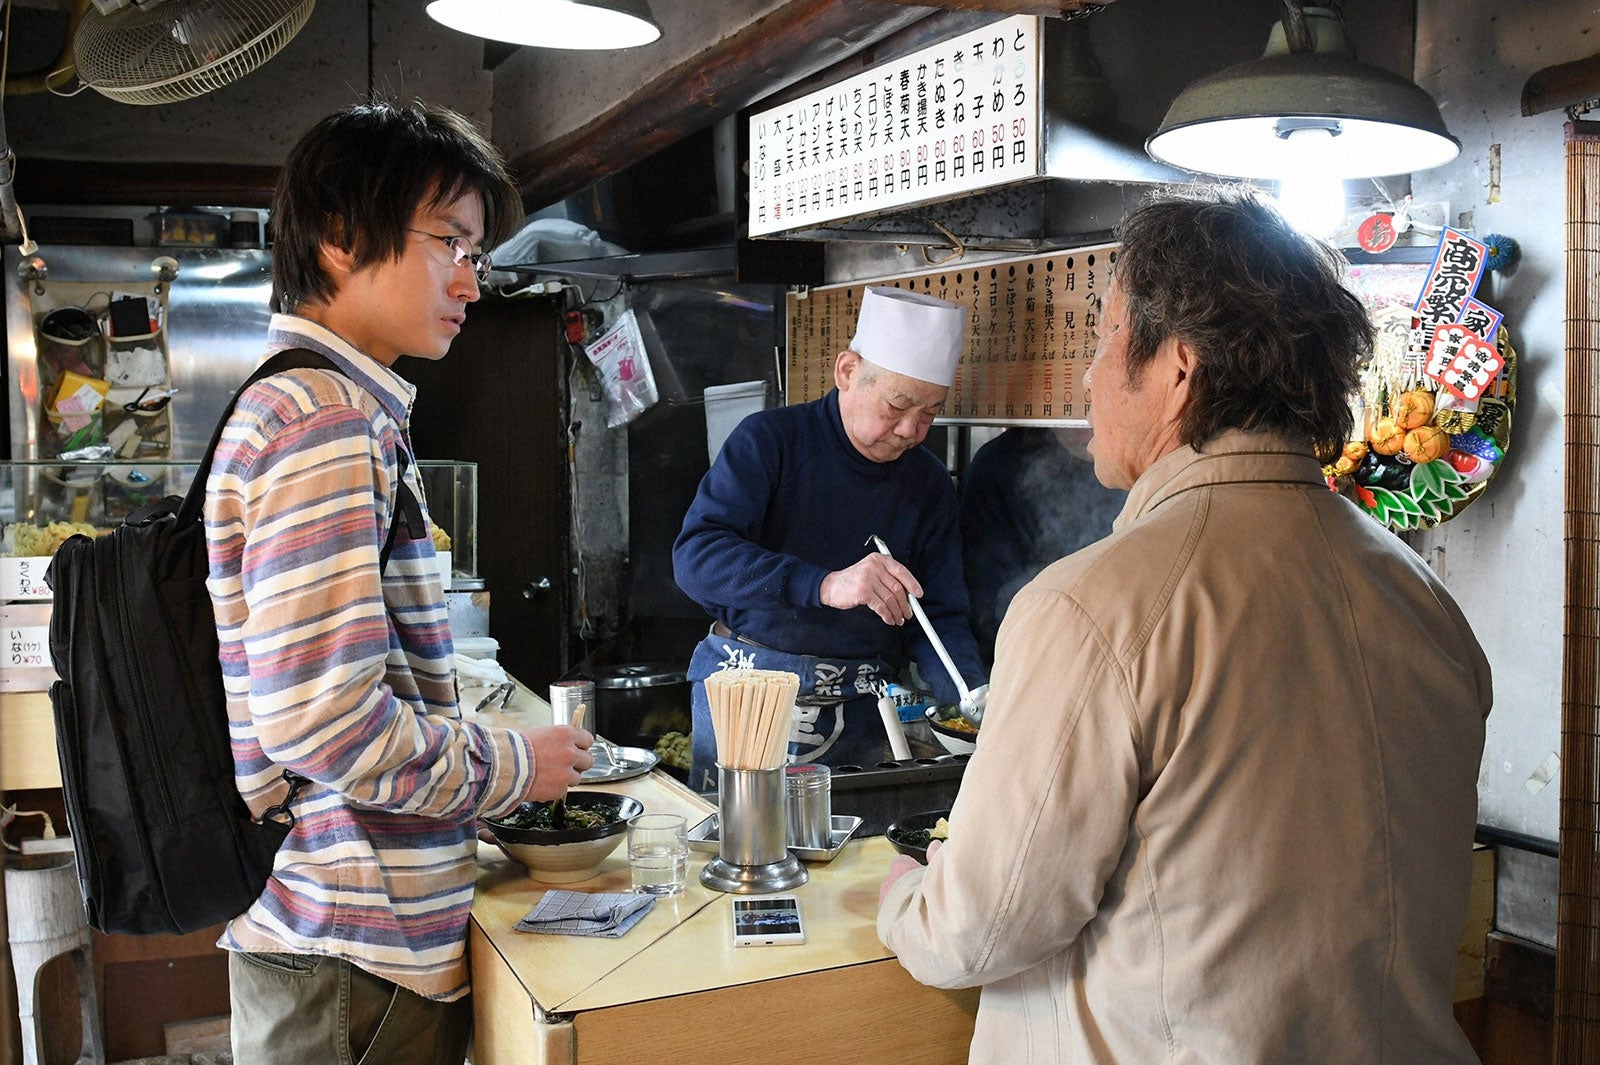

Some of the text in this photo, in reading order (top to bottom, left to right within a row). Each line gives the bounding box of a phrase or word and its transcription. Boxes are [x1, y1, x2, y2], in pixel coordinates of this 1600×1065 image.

[825, 96, 834, 162] げそ天
[839, 93, 848, 158] いも天
[854, 88, 863, 154] ちくわ天
[900, 69, 911, 191] 春菊天 80円
[917, 63, 928, 187] かき揚天 80円
[934, 57, 946, 183] たぬき 60円
[953, 50, 965, 179] きつね 60円
[972, 42, 985, 174] 玉子 60円
[992, 36, 1005, 170] わかめ 50円
[758, 123, 767, 181] いなり
[799, 108, 807, 170] いか天
[811, 102, 820, 167] アジ天
[884, 73, 894, 195] ごぼう天 80円
[1012, 117, 1026, 165] 50円
[971, 283, 981, 337] ちくわ天
[1006, 278, 1017, 335] ごぼう天
[1025, 277, 1035, 333] 春菊天
[1044, 274, 1055, 332] かき揚天
[1064, 272, 1076, 331] 月見
[1085, 269, 1096, 328] きつね
[1068, 330, 1076, 359] そば
[20, 561, 31, 596] ちくわ天
[11, 630, 22, 665] いなり
[23, 655, 42, 664] ¥70
